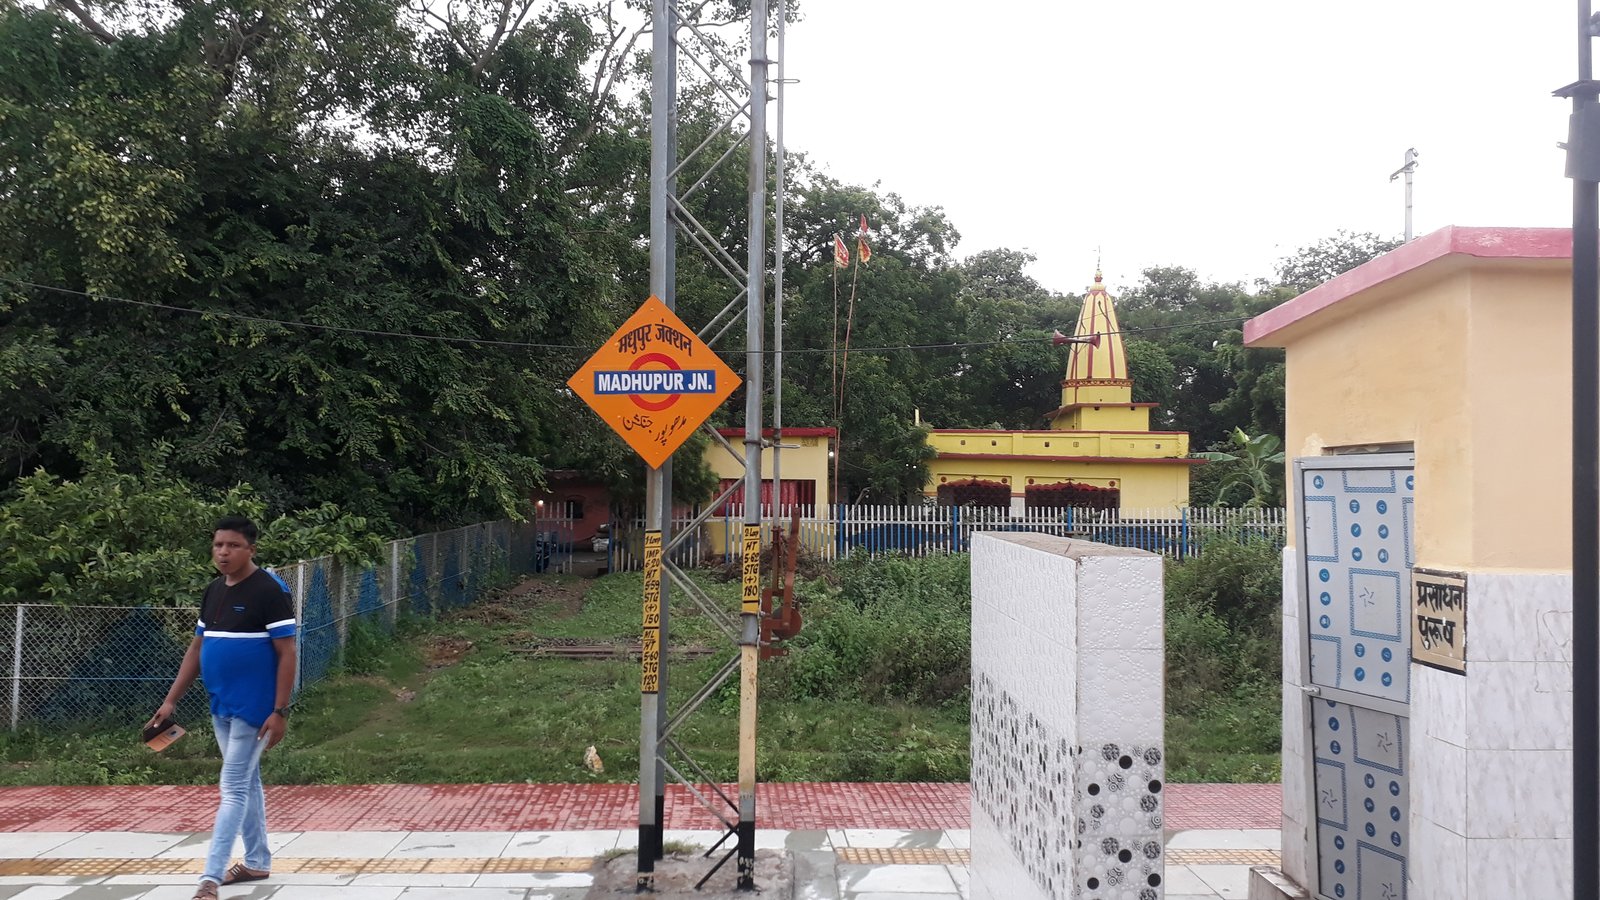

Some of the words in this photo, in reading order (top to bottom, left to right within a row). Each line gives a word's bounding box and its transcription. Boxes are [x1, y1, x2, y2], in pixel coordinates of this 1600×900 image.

[618, 324, 652, 355] मधुपुर
[655, 318, 692, 357] जंक्शन
[598, 373, 684, 391] MADHUPUR
[688, 372, 712, 391] JN.
[745, 541, 758, 551] HT
[645, 569, 658, 579] HT
[744, 563, 759, 575] STG
[743, 585, 758, 597] 180
[644, 592, 659, 603] STG
[1416, 581, 1464, 613] प्रसाधन
[644, 614, 659, 624] 150
[644, 640, 656, 651] HT
[643, 662, 658, 673] STG
[643, 674, 657, 685] 120
